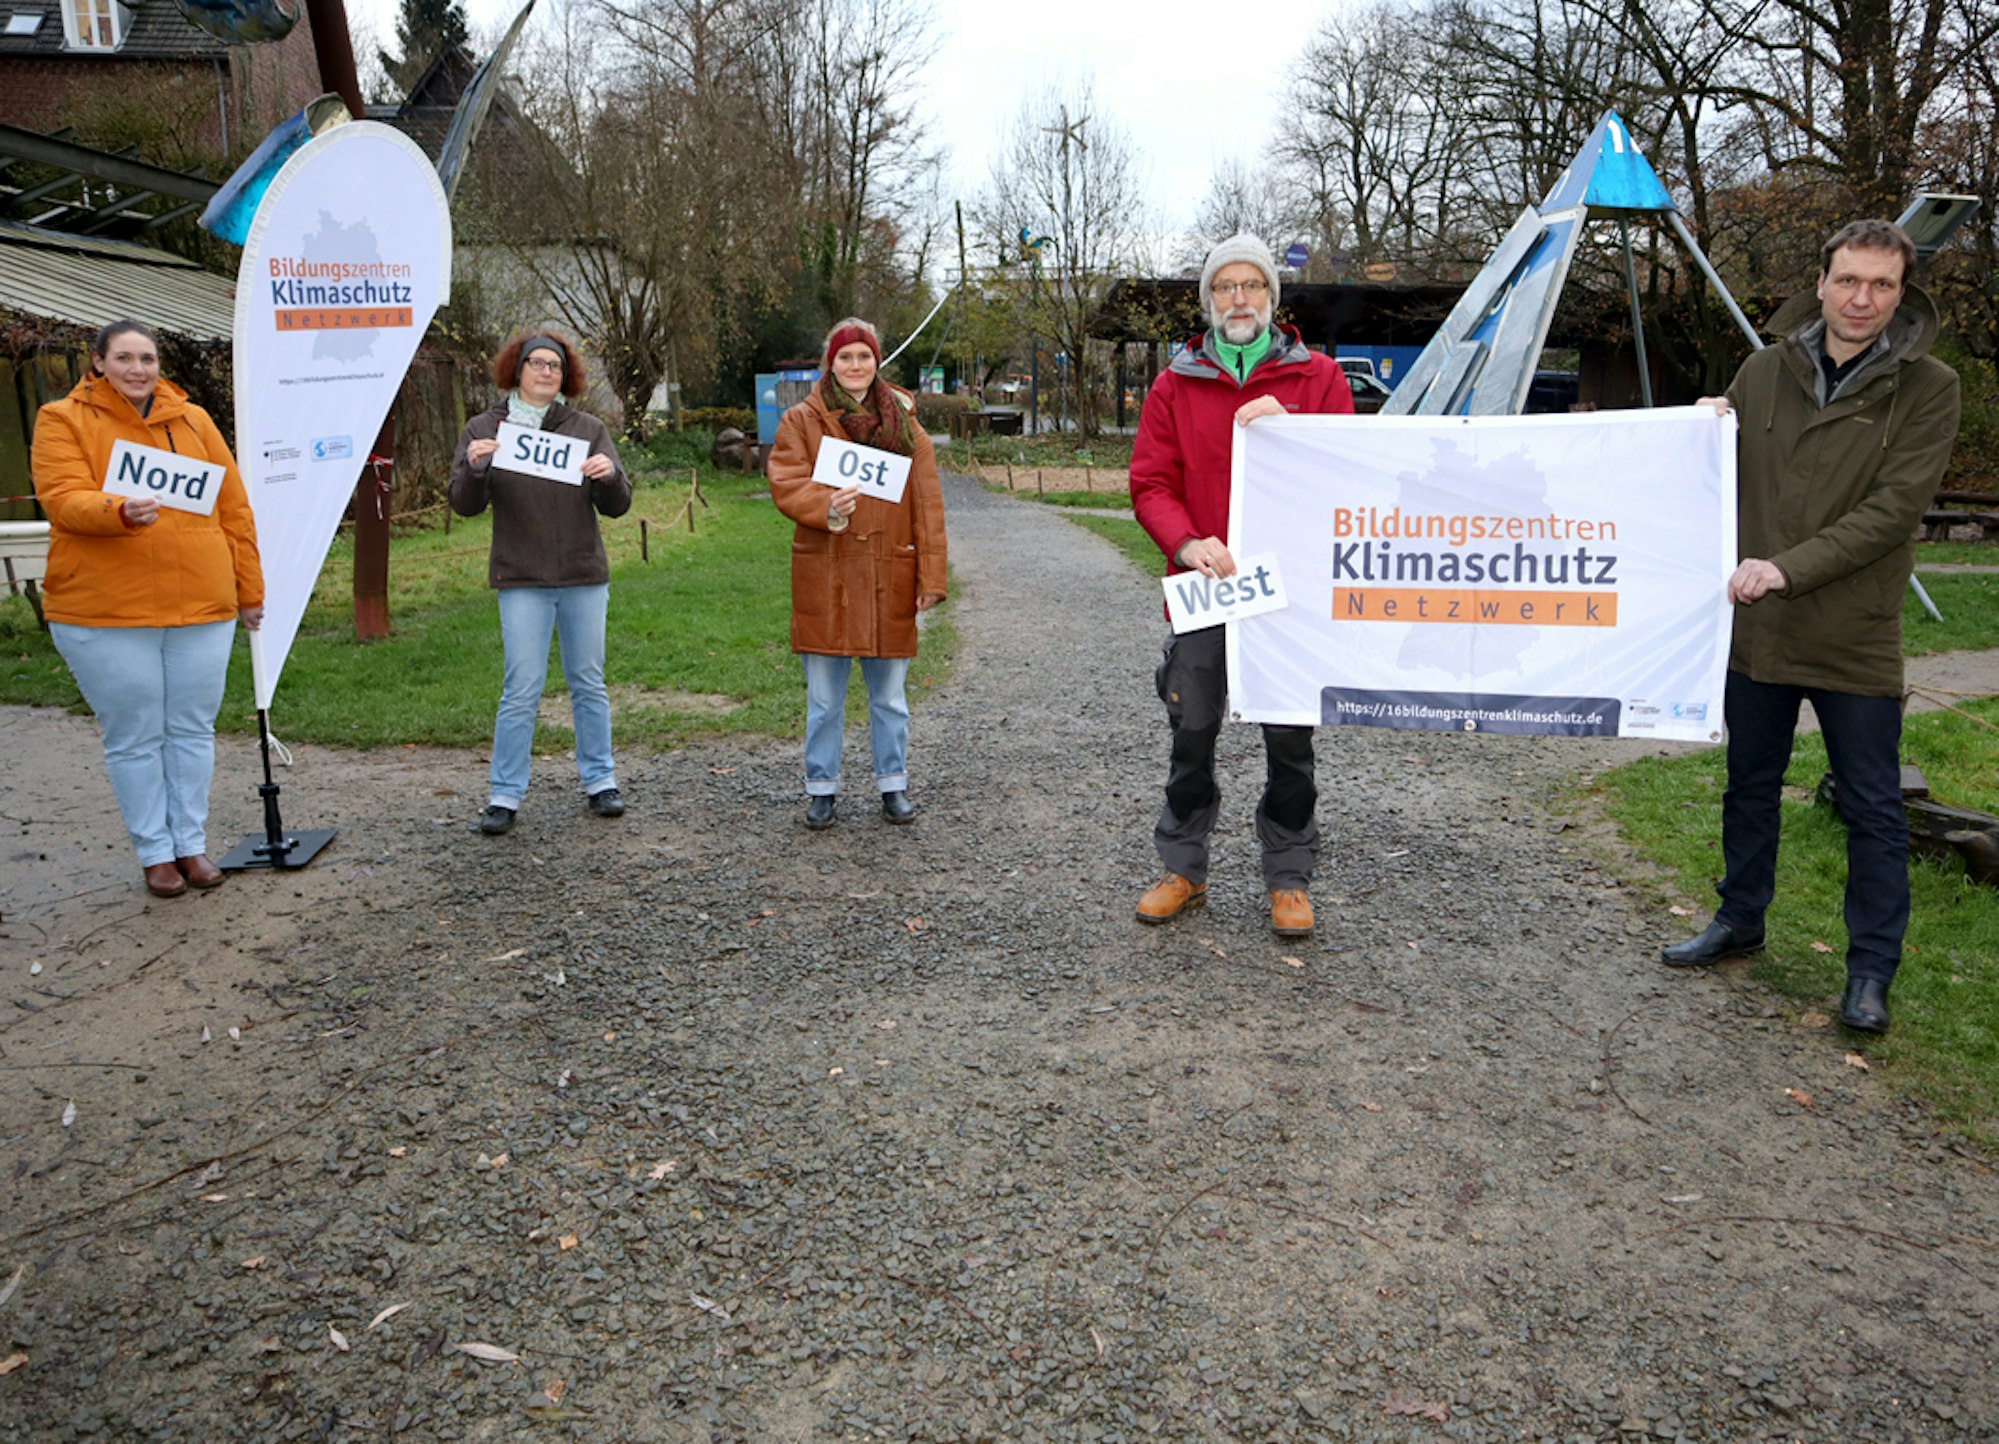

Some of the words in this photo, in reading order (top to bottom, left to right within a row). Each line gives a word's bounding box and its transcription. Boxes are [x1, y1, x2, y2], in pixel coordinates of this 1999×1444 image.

[269, 257, 411, 282] Bildungszentren
[271, 279, 412, 305] Klimaschutz
[283, 312, 405, 327] Netzwerk
[514, 433, 571, 470] Süd
[838, 449, 889, 487] Ost
[117, 450, 209, 501] Nord
[1333, 506, 1617, 547] Bildungszentren
[1332, 541, 1618, 585] Klimaschutz
[1175, 565, 1276, 616] West
[1347, 592, 1600, 622] Netzwerk
[1335, 700, 1604, 726] https://16bildungszentrenklimaschutz.de
